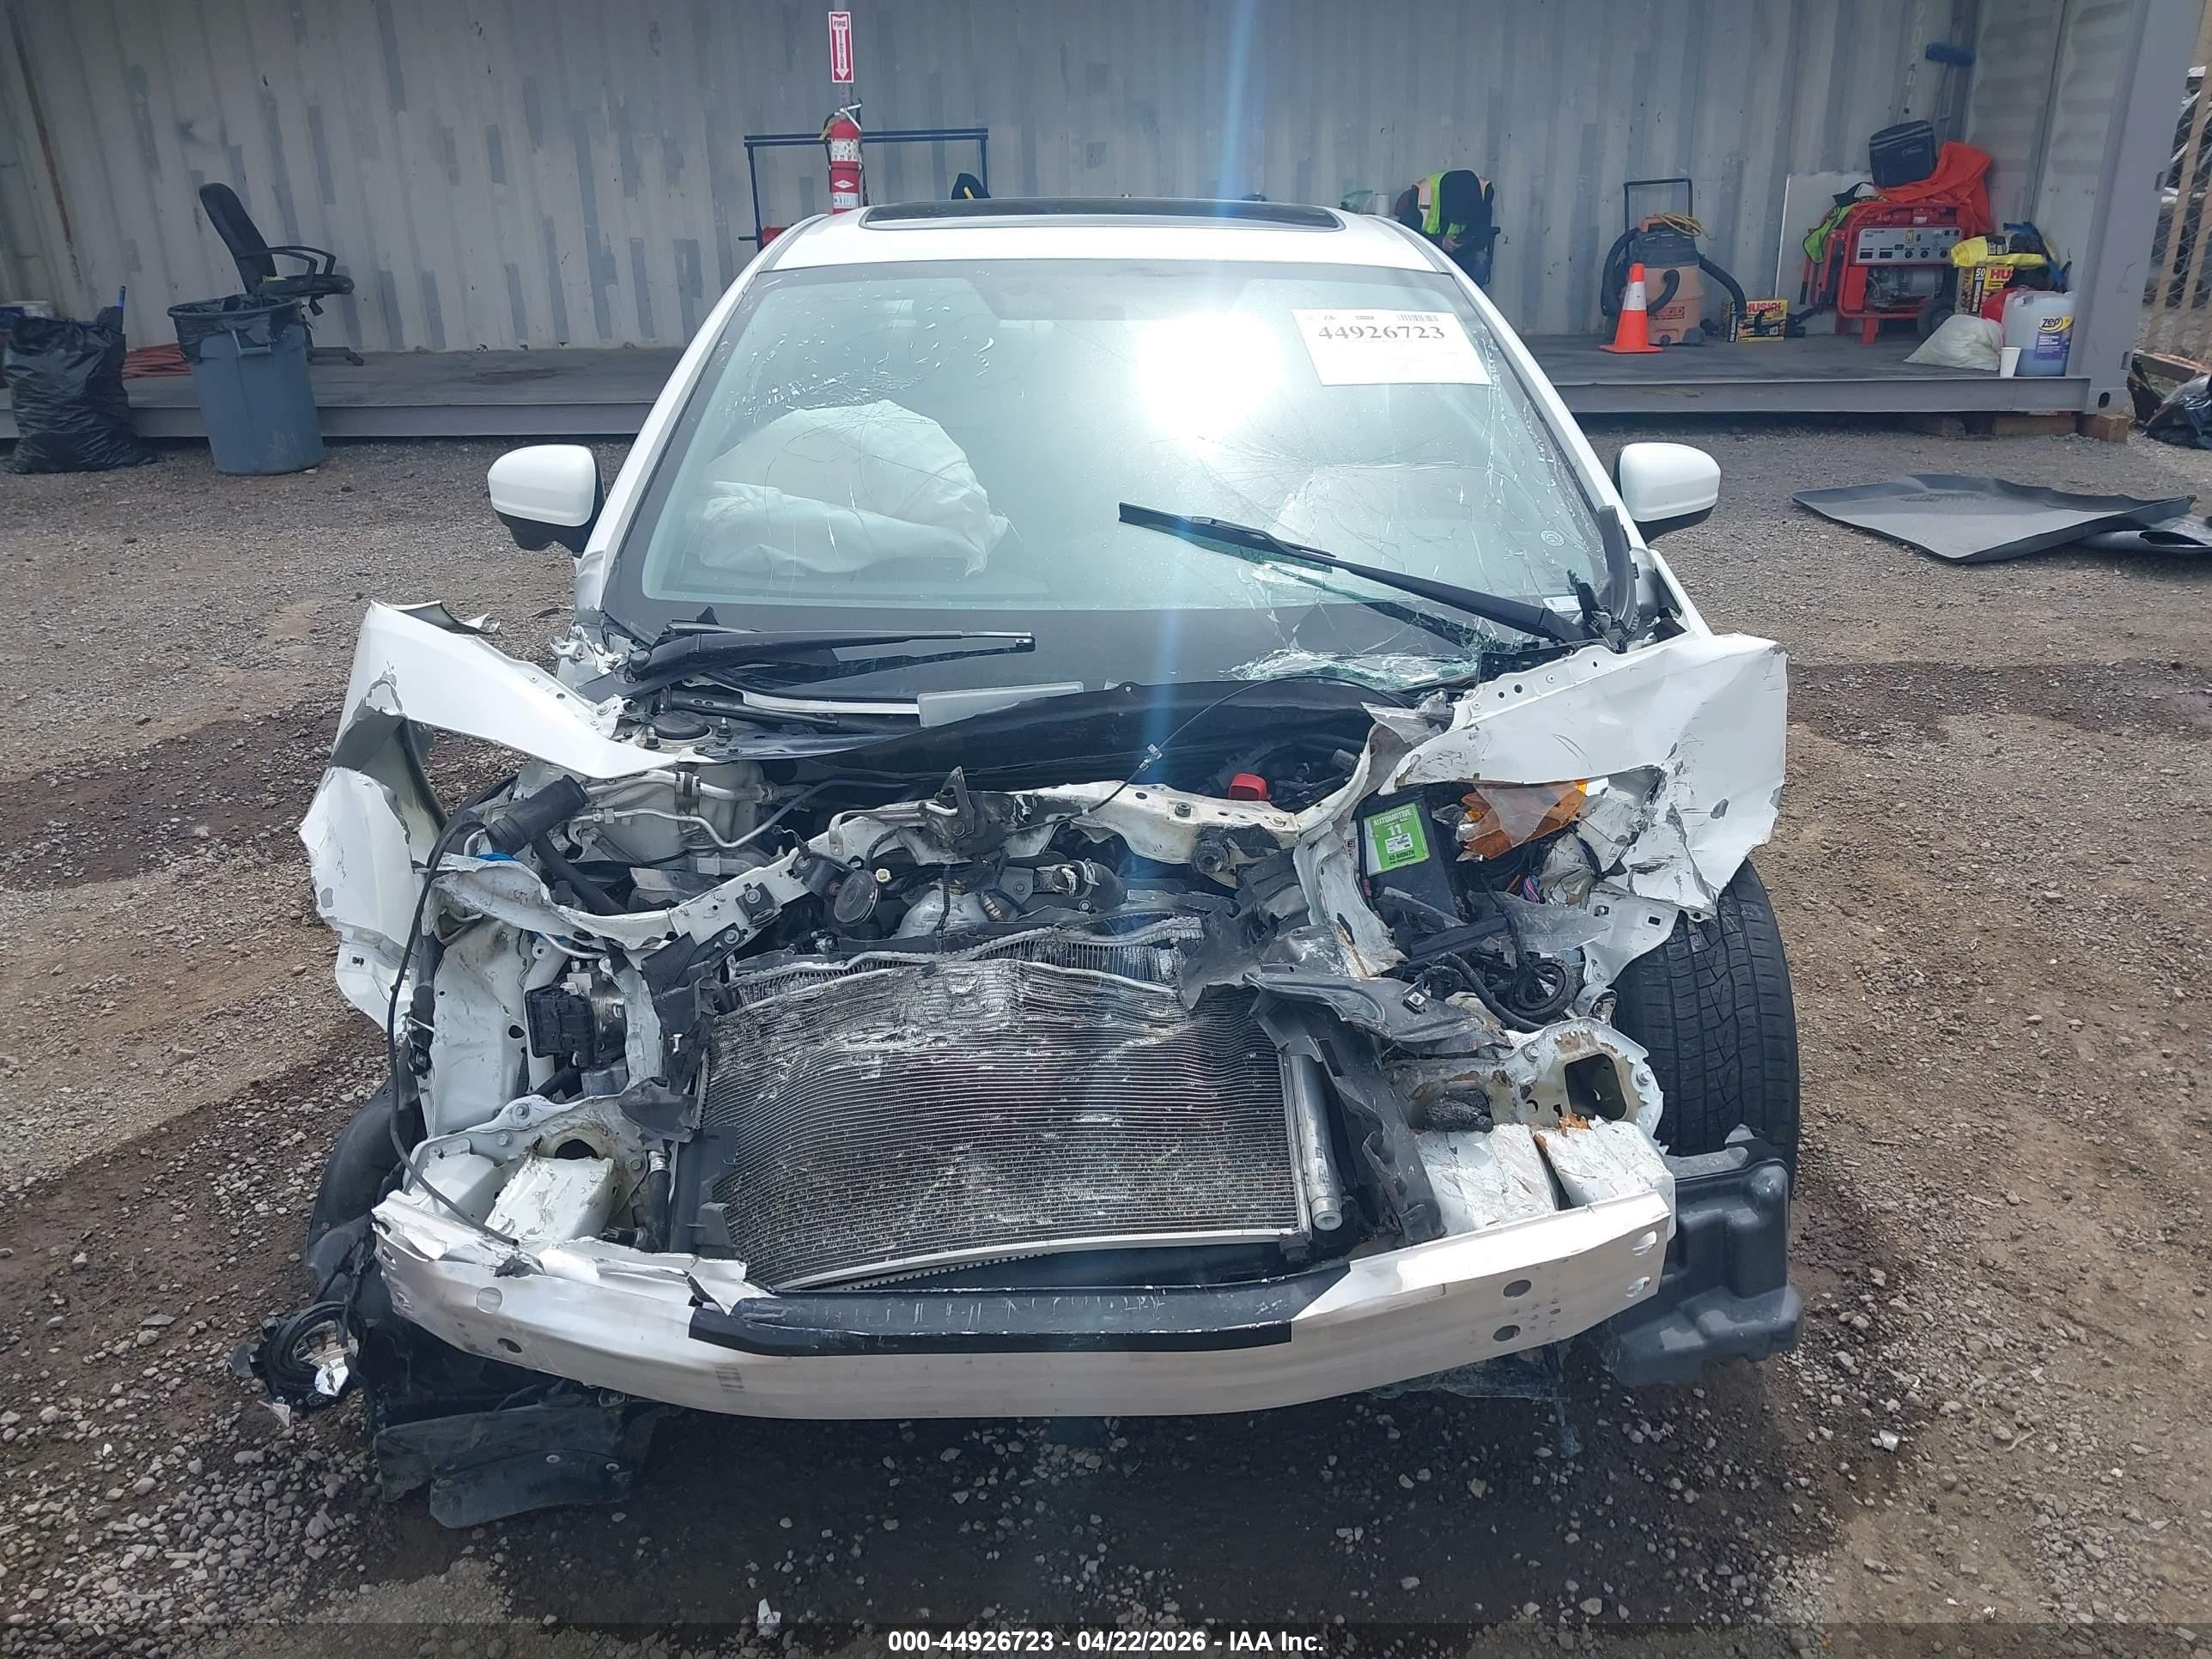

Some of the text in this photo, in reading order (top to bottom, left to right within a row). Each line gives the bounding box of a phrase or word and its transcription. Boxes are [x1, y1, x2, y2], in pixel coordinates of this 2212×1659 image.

[1976, 268, 1986, 276] 50
[1319, 325, 1445, 339] 44926723
[1373, 809, 1413, 827] AUTOMOTIVE
[1388, 823, 1403, 836] 11
